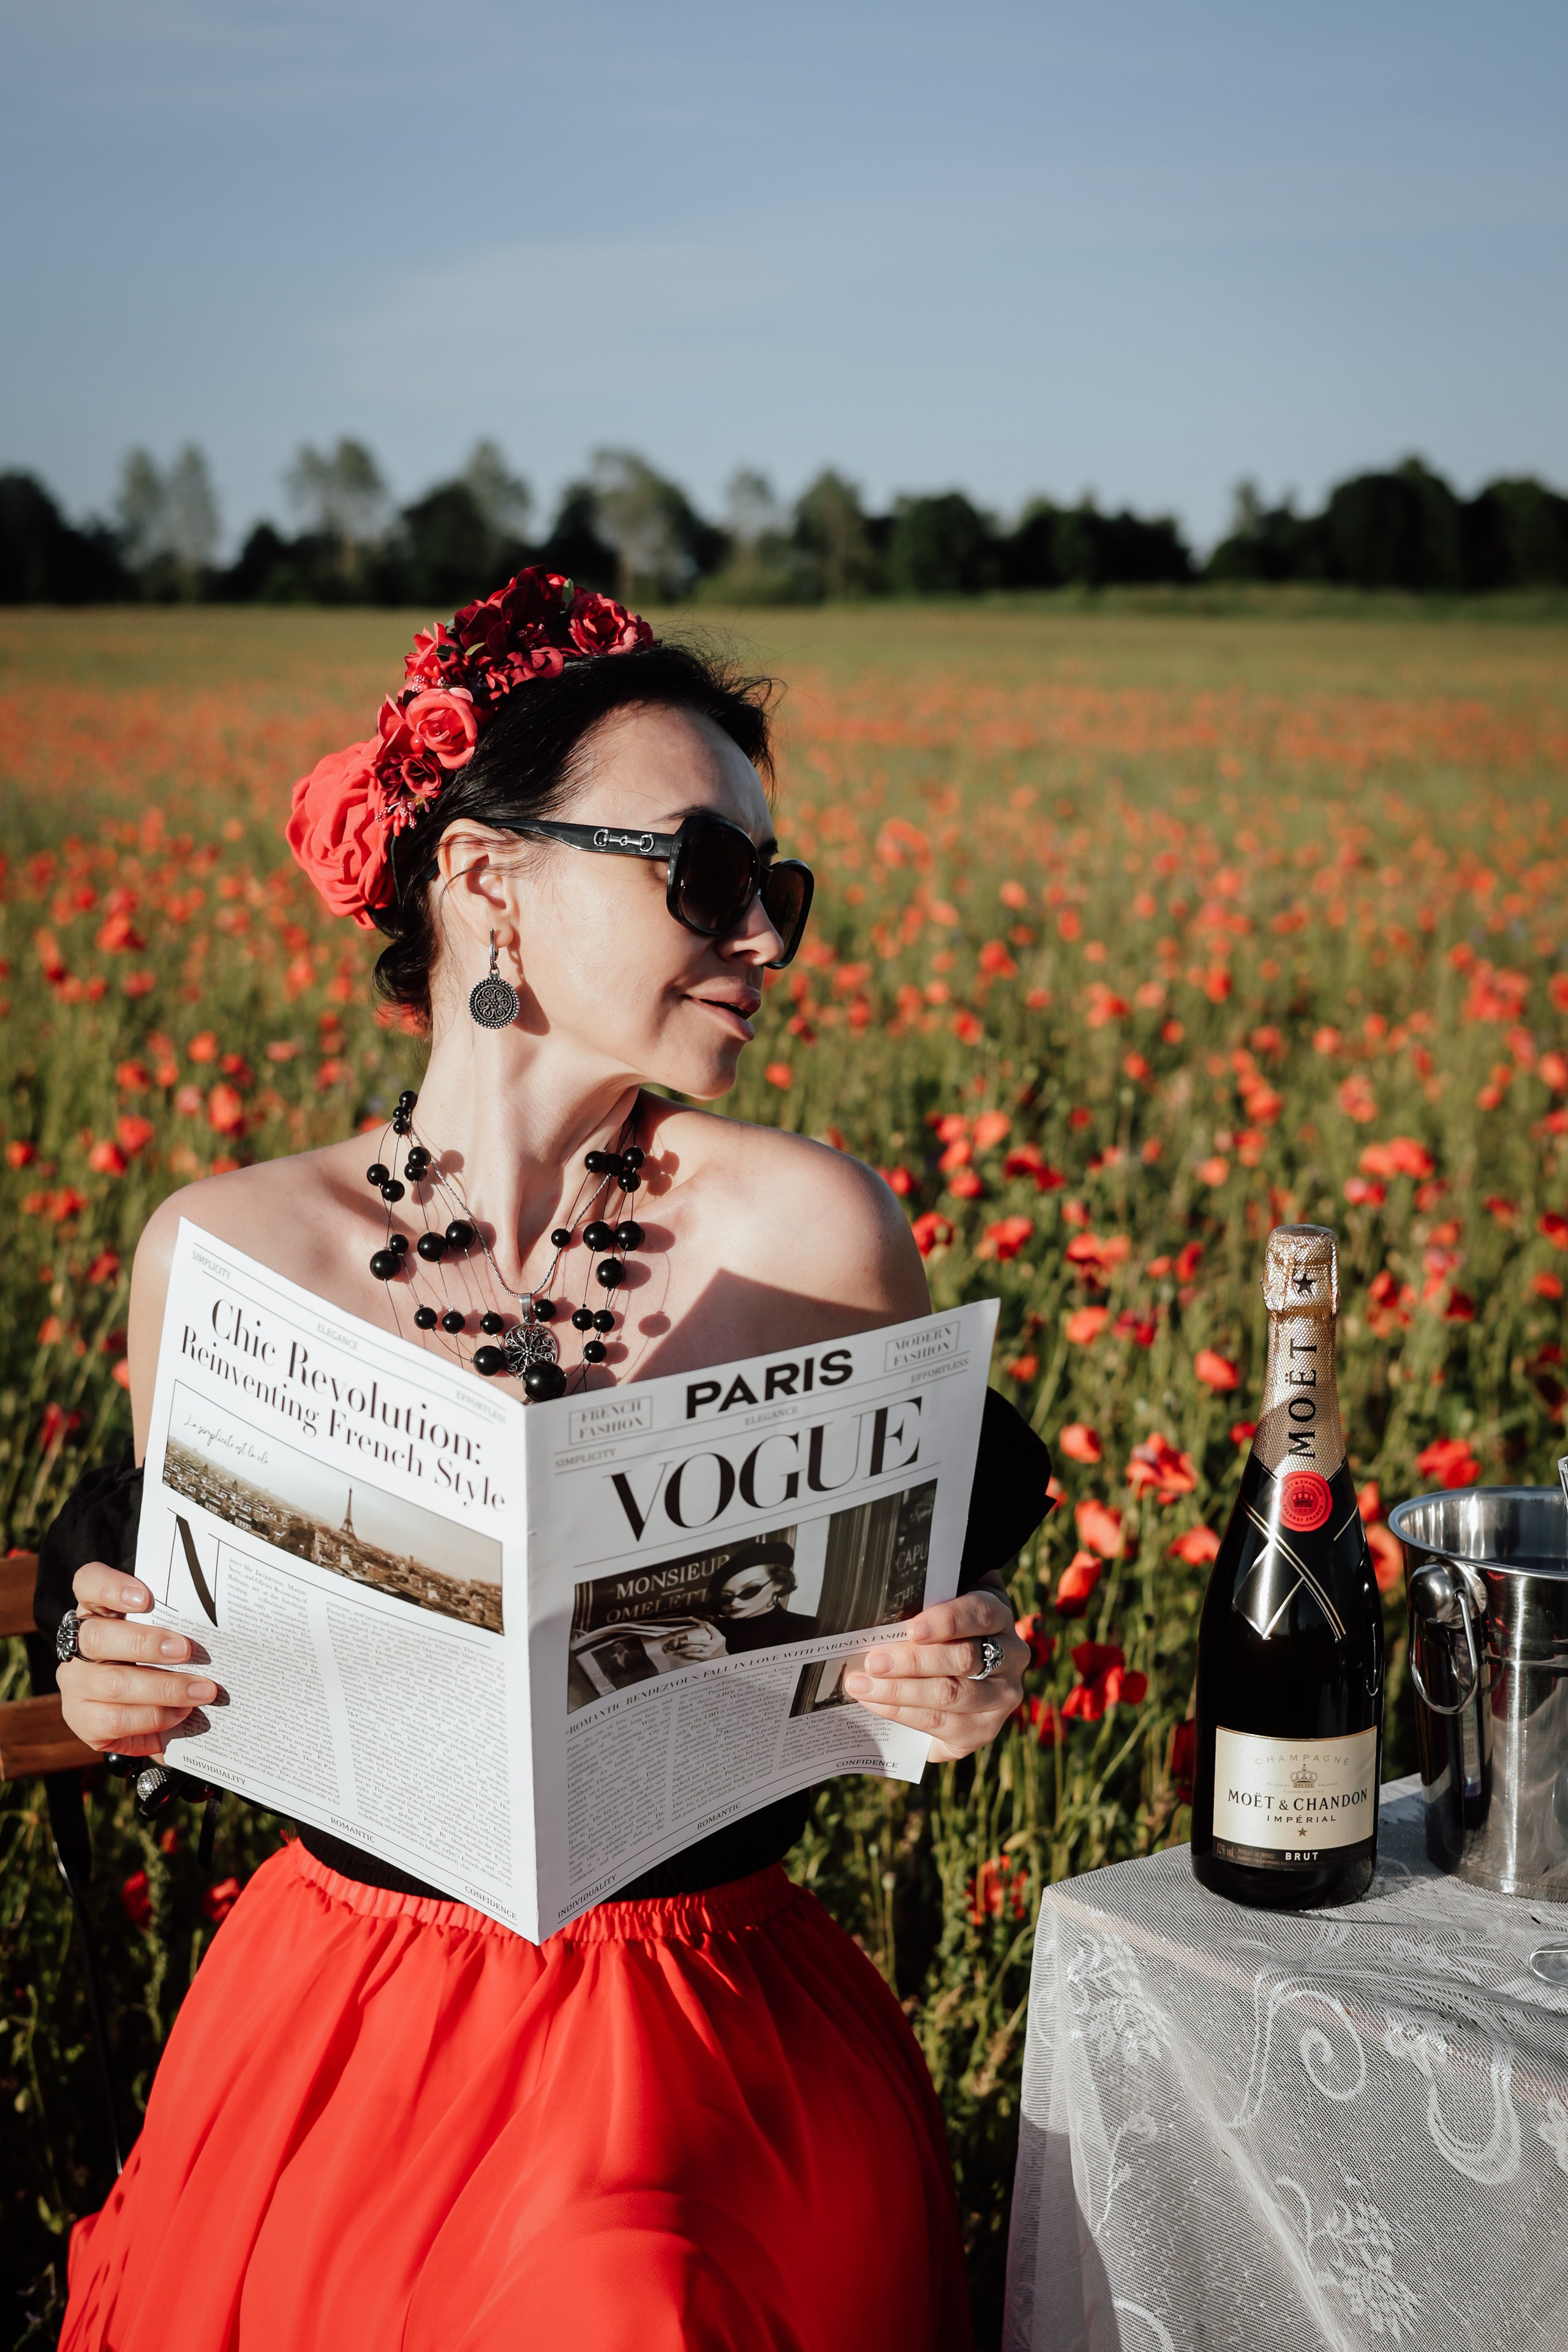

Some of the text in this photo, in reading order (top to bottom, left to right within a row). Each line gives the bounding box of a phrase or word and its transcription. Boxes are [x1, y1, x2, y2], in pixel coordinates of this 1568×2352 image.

[192, 1251, 231, 1280] SIMPLICITY
[317, 1322, 360, 1352] ELEGANCE
[895, 1327, 951, 1350] MODERN
[894, 1341, 949, 1366] FASHION
[212, 1299, 481, 1465] Chic Revolution:
[911, 1357, 969, 1382] EFFORTLESS
[686, 1349, 853, 1419] PARIS
[456, 1390, 507, 1425] EFFORTLESS
[581, 1400, 641, 1423] FRENCH
[1285, 1338, 1317, 1459] MOËT
[180, 1324, 505, 1512] Reinventing French Style
[579, 1417, 643, 1439] FASHION
[744, 1405, 798, 1425] ELEGANCE
[554, 1448, 616, 1468] SIMPLICITY
[602, 1396, 923, 1542] VOGUE
[227, 1600, 257, 1614] sensibilities
[274, 1618, 306, 1632] maintaining
[227, 1607, 258, 1623] distinctively
[260, 1618, 279, 1629] French
[300, 1630, 311, 1639] The
[271, 1610, 309, 1626] contemporary
[704, 1664, 732, 1678] FALL
[734, 1661, 745, 1670] IN
[750, 1654, 779, 1666] LOVE
[783, 1648, 813, 1659] WITH
[817, 1637, 868, 1653] PARISIAN
[690, 1686, 710, 1695] essence
[722, 1676, 741, 1686] French
[778, 1664, 794, 1673] staple
[708, 1686, 731, 1695] Parisian
[782, 1743, 804, 1752] strolling
[784, 1732, 808, 1741] romantic
[778, 1760, 801, 1770] modern
[791, 1751, 814, 1760] embrace
[836, 1759, 899, 1768] CONFIDENCE
[1255, 1754, 1350, 1765] CHAMPAGNE
[183, 1755, 246, 1785] INDIVIDUALITY
[1227, 1788, 1368, 1811] MOËT & CHANDON
[698, 1802, 742, 1830] ROMANTIC
[331, 1817, 375, 1843] ROMANTIC
[358, 1811, 383, 1827] redefining
[385, 1823, 396, 1833] what
[402, 1833, 418, 1844] means
[432, 1849, 458, 1866] exclusively
[1285, 1852, 1319, 1861] BRUT
[465, 1885, 517, 1921] CONFIDENCE
[558, 1874, 617, 1919] INDIVIDUALITY
